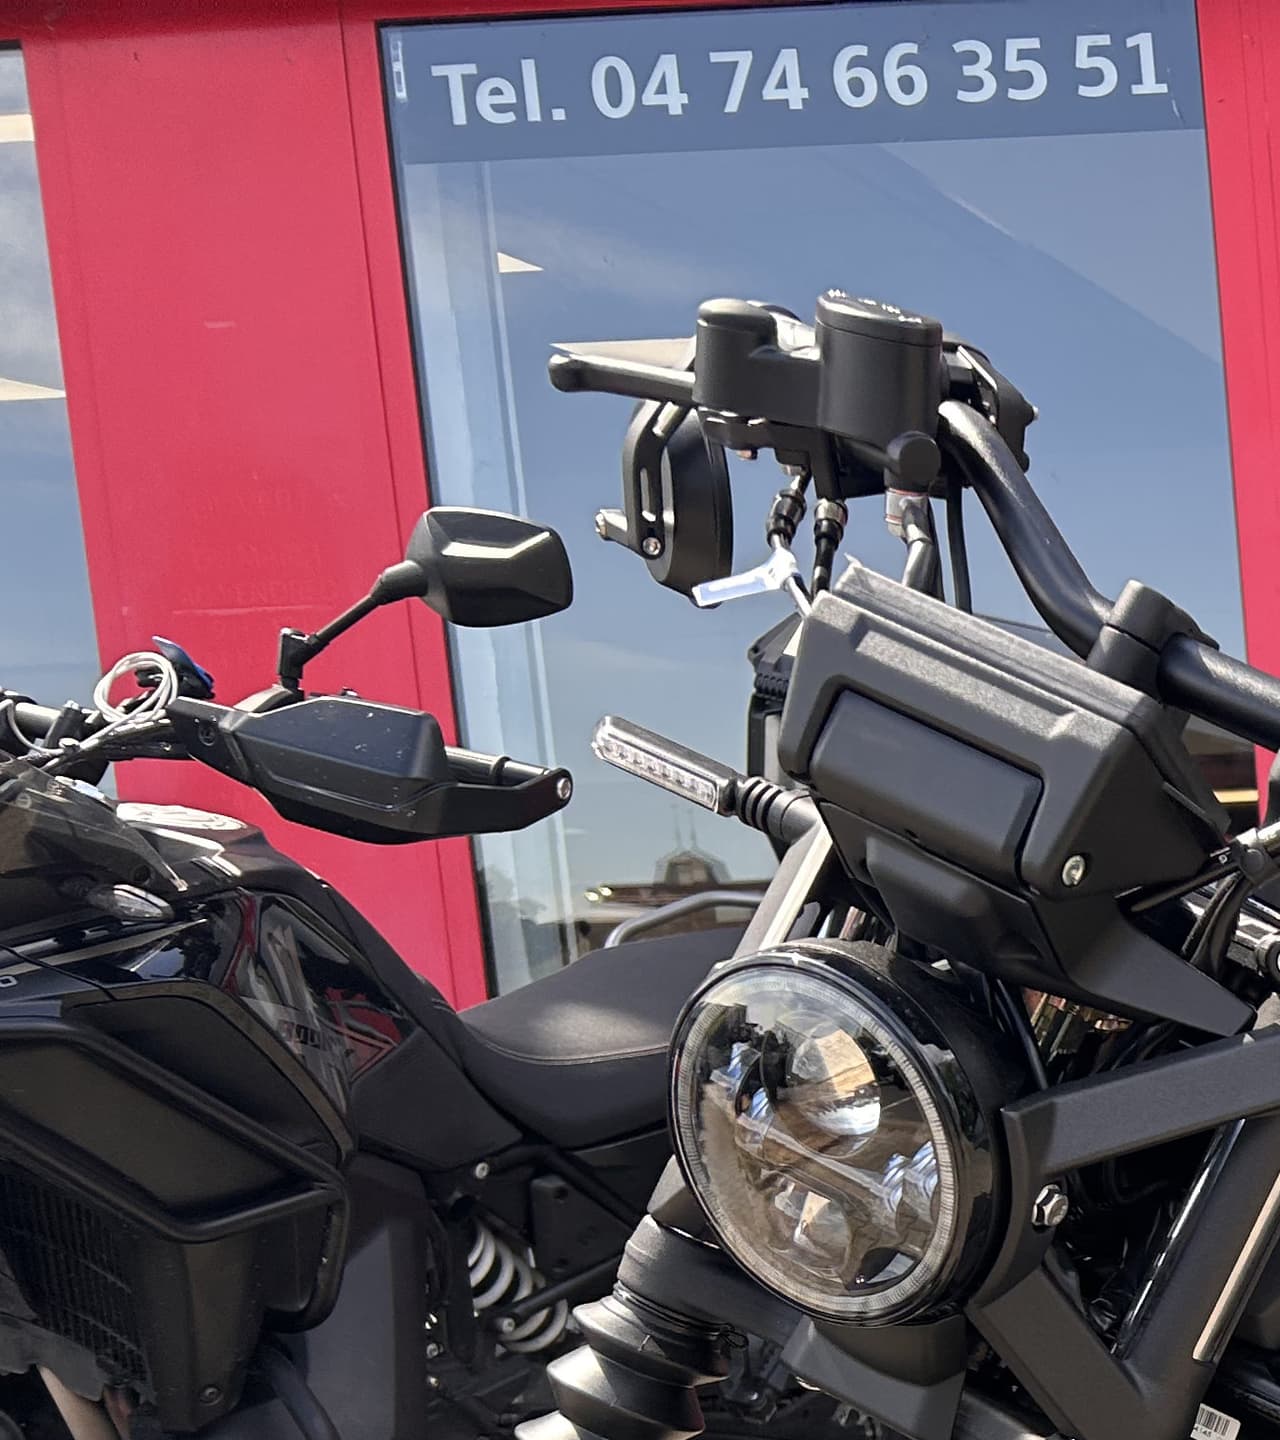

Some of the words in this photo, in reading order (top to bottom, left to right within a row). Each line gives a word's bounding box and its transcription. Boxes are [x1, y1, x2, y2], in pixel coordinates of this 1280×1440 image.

[431, 58, 566, 126] Tel.
[590, 53, 688, 119] 04
[709, 49, 809, 115] 74
[832, 42, 929, 109] 66
[953, 37, 1049, 103] 35
[1074, 31, 1169, 98] 51
